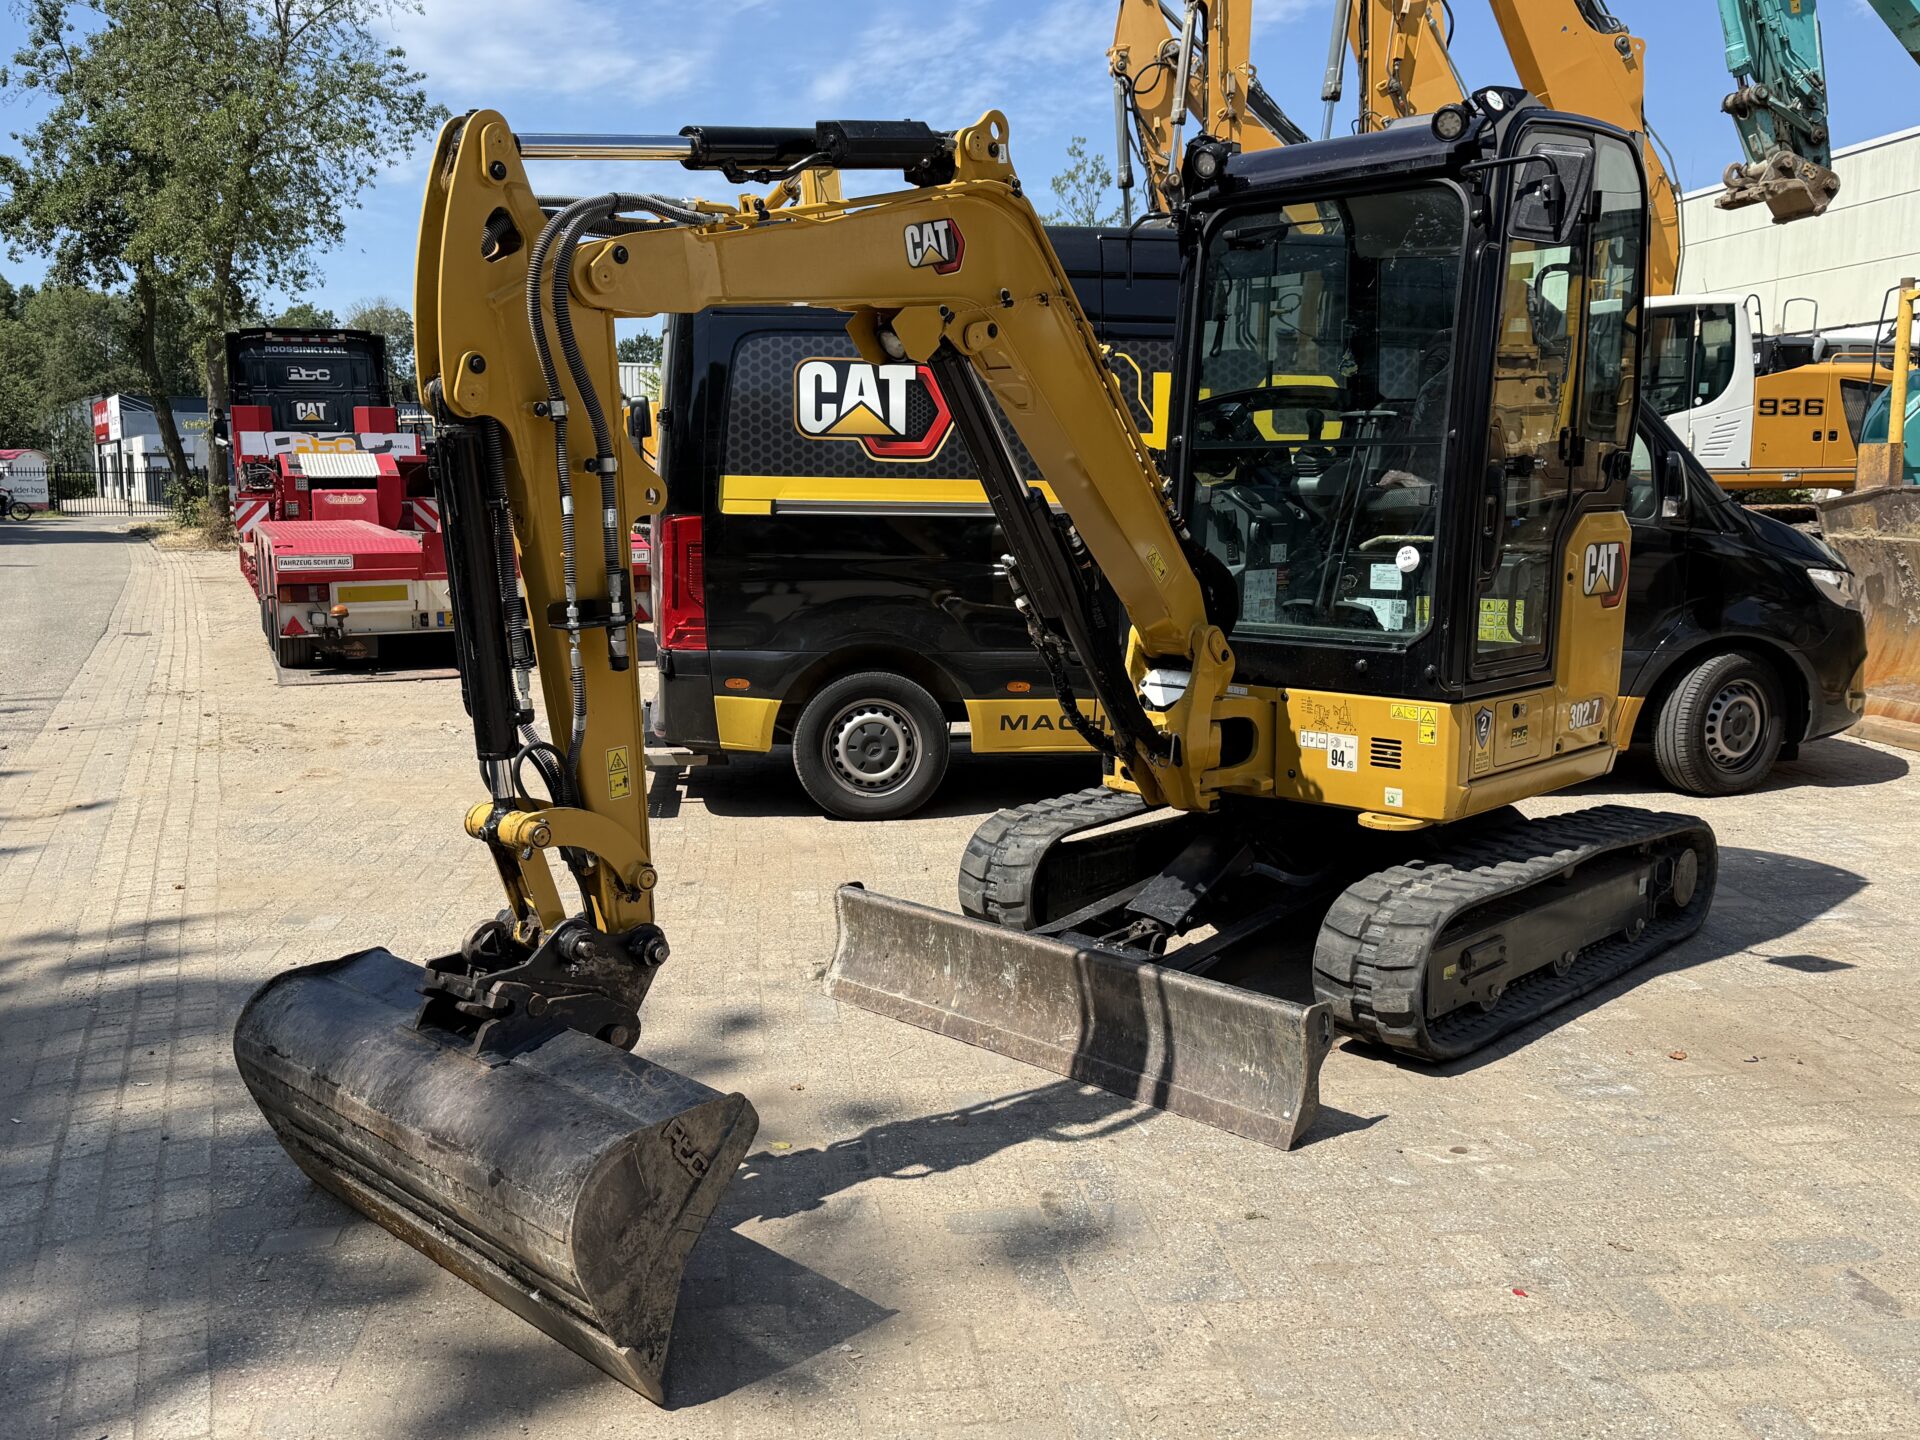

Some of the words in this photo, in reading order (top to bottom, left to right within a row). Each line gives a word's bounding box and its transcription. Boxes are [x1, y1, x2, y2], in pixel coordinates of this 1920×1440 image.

[904, 220, 949, 267] CAT
[800, 361, 916, 435] CAT
[1758, 398, 1824, 416] 936
[296, 402, 326, 421] CAT
[280, 559, 312, 567] FAHRZEUG
[313, 558, 337, 566] SCHERT
[1583, 543, 1619, 595] CAT
[1000, 715, 1114, 731] MACH
[1480, 716, 1488, 732] 2
[1569, 699, 1600, 731] 302.7
[1331, 749, 1345, 768] 94
